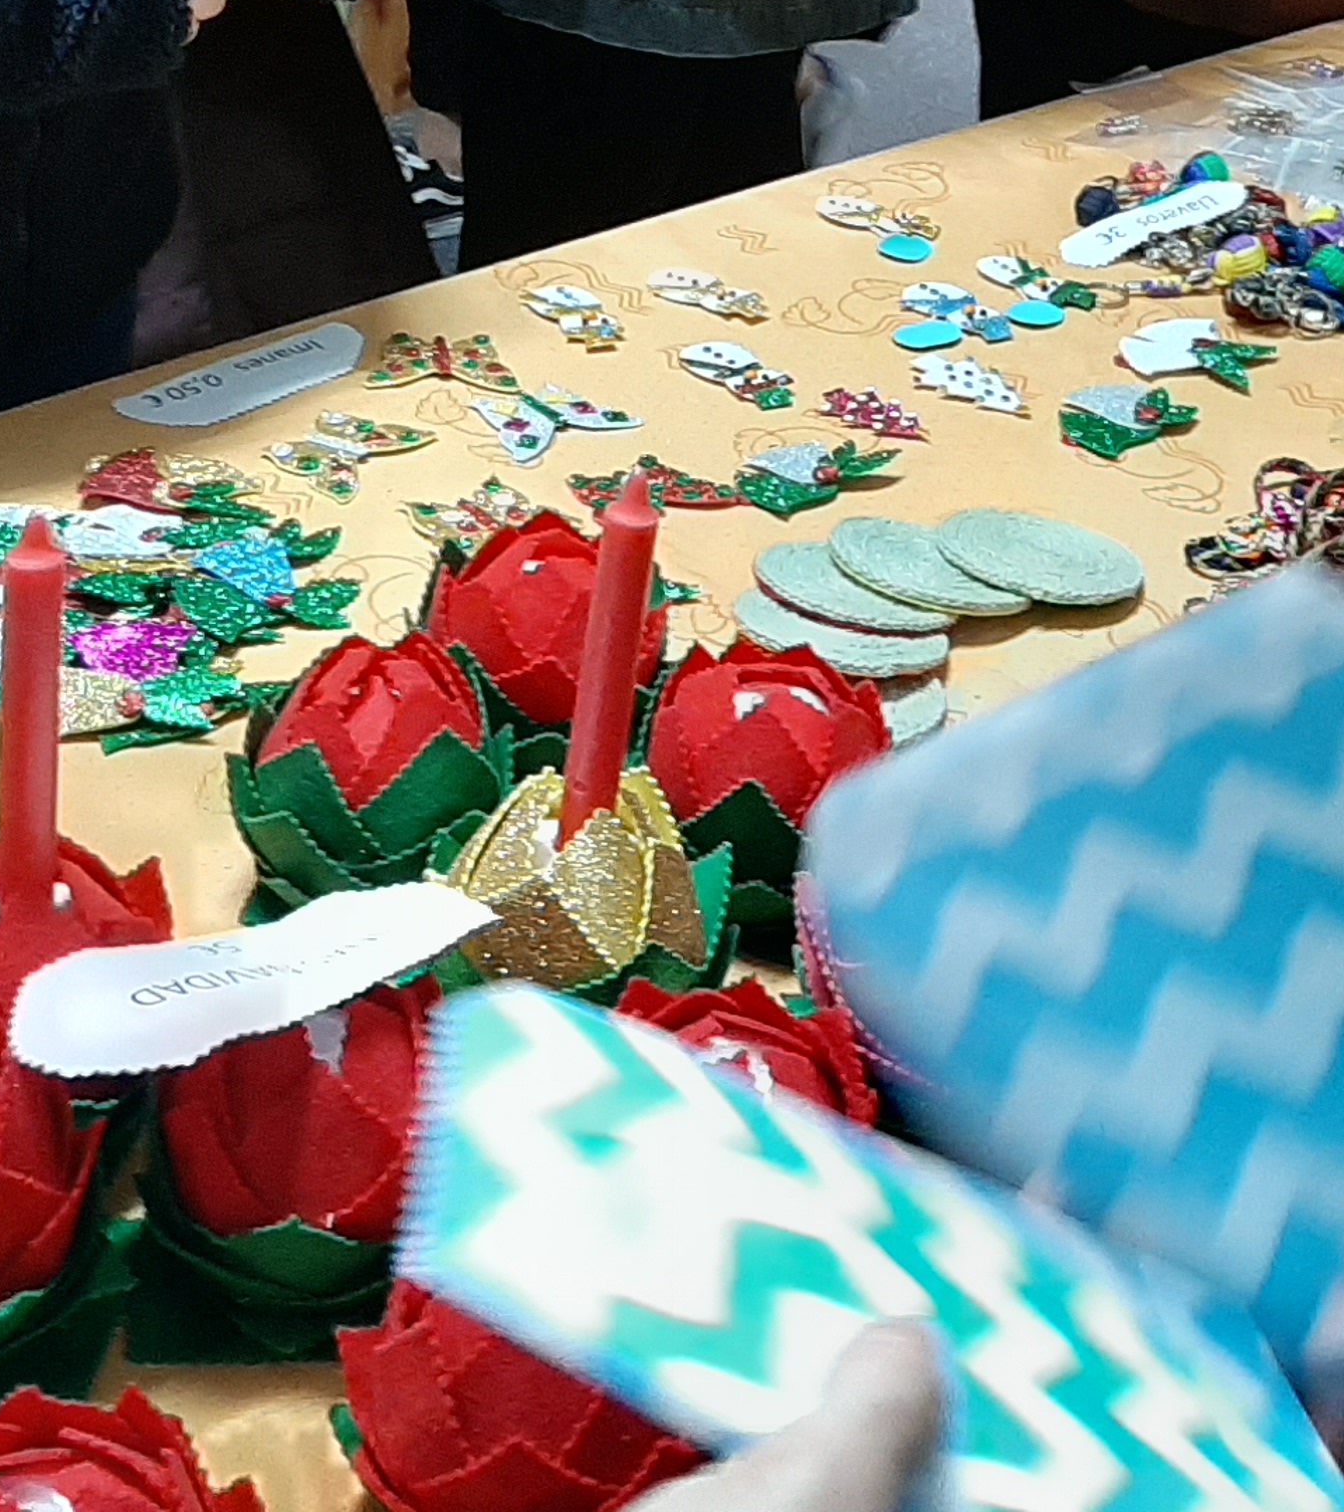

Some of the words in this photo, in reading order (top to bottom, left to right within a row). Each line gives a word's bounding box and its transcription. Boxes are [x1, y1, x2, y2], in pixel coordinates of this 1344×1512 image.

[1136, 194, 1220, 227] Llaveros
[233, 338, 325, 372] Imanes
[140, 391, 165, 409] €
[165, 374, 223, 401] 0,50
